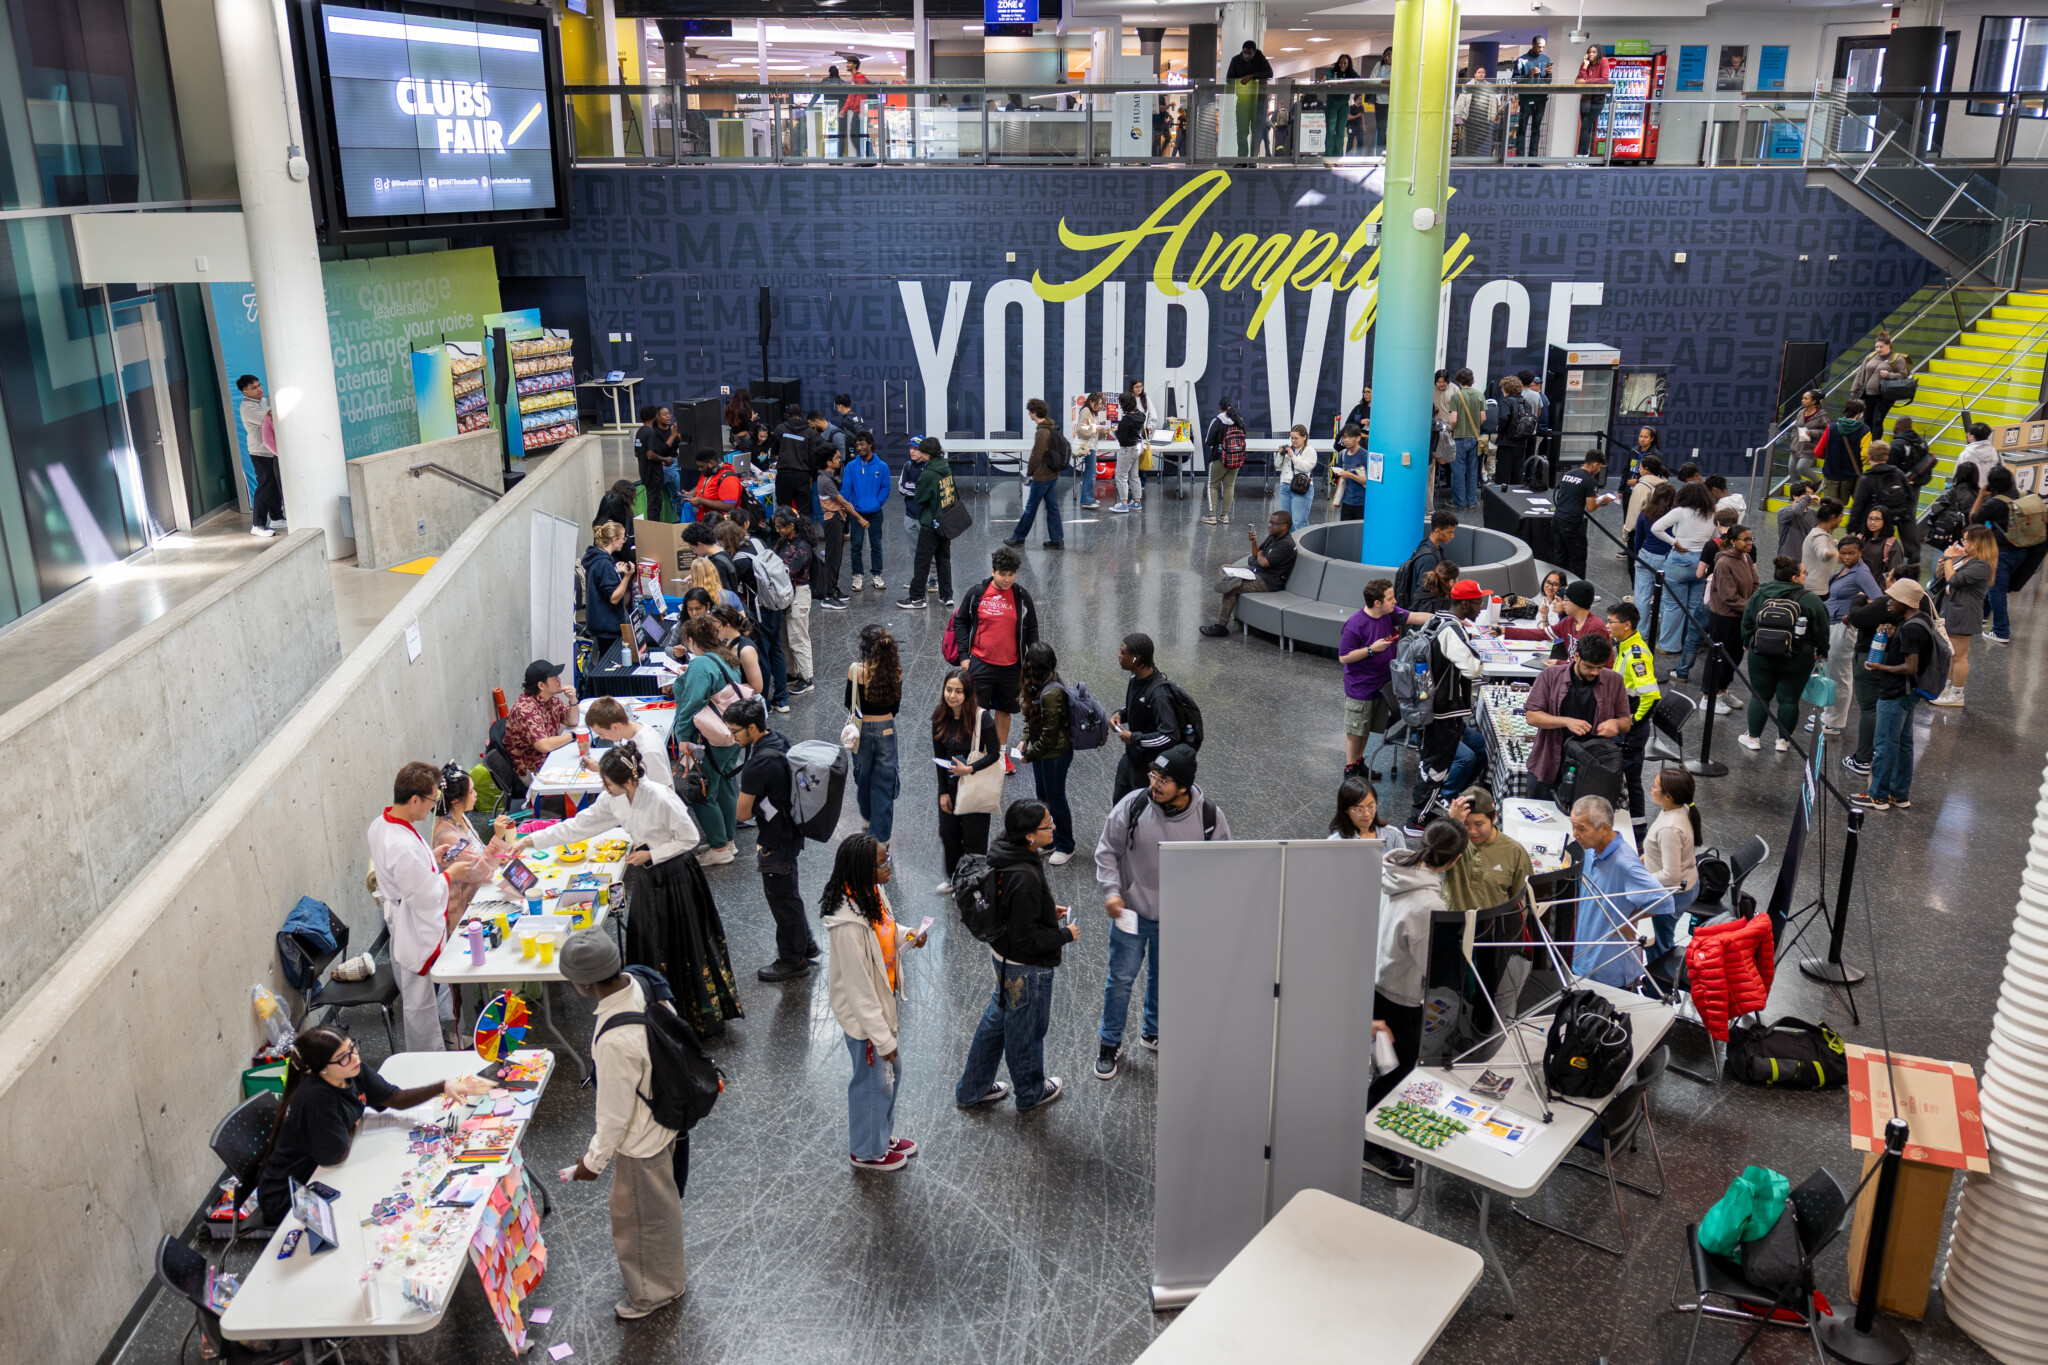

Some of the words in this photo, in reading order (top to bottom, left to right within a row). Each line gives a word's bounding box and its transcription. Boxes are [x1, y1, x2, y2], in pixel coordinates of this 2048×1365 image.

[396, 76, 491, 118] CLUBS
[1133, 80, 1141, 124] HUMBR
[436, 118, 506, 154] FAIR
[584, 174, 845, 217] DISCOVER
[850, 173, 1015, 196] COMMUNITY
[1019, 174, 1138, 199] INSPIRE
[1472, 173, 1595, 200] CREATE
[1611, 175, 1708, 197] INVENT
[955, 200, 1014, 216] SHAPE
[1019, 200, 1067, 216] YOUR
[1072, 200, 1135, 216] WORLD
[1447, 203, 1497, 217] SHAPE
[1500, 204, 1541, 217] YOUR
[1545, 204, 1600, 217] WORLD
[1609, 200, 1704, 217] CONNECT
[877, 221, 1005, 244] DISCOVER
[1514, 219, 1551, 229] BETTER
[1554, 219, 1608, 229] TOGETHER
[1605, 219, 1792, 245] REPRESENT
[675, 222, 846, 269] MAKE
[877, 244, 999, 269] INSPIRE
[1602, 248, 1751, 285] IGNITE
[358, 275, 452, 311] courage
[682, 274, 743, 290] IGNITE
[750, 272, 847, 290] ADVOCATE
[373, 297, 430, 320] leadership
[1602, 288, 1746, 308] COMMUNITY
[1786, 291, 1895, 308] ADVOCATE
[329, 316, 394, 345] atness
[402, 320, 435, 345] your
[437, 310, 475, 333] voice
[1615, 311, 1739, 333] CATALYZE
[333, 335, 410, 369] change
[745, 335, 917, 361] COMMUNIT
[897, 278, 1210, 440] YOUR
[337, 358, 393, 393] otential
[347, 393, 417, 424] community
[1671, 410, 1766, 426] ADVOCATE
[1562, 474, 1582, 485] STAFF
[2018, 470, 2030, 478] STEP
[2018, 478, 2025, 490] 4
